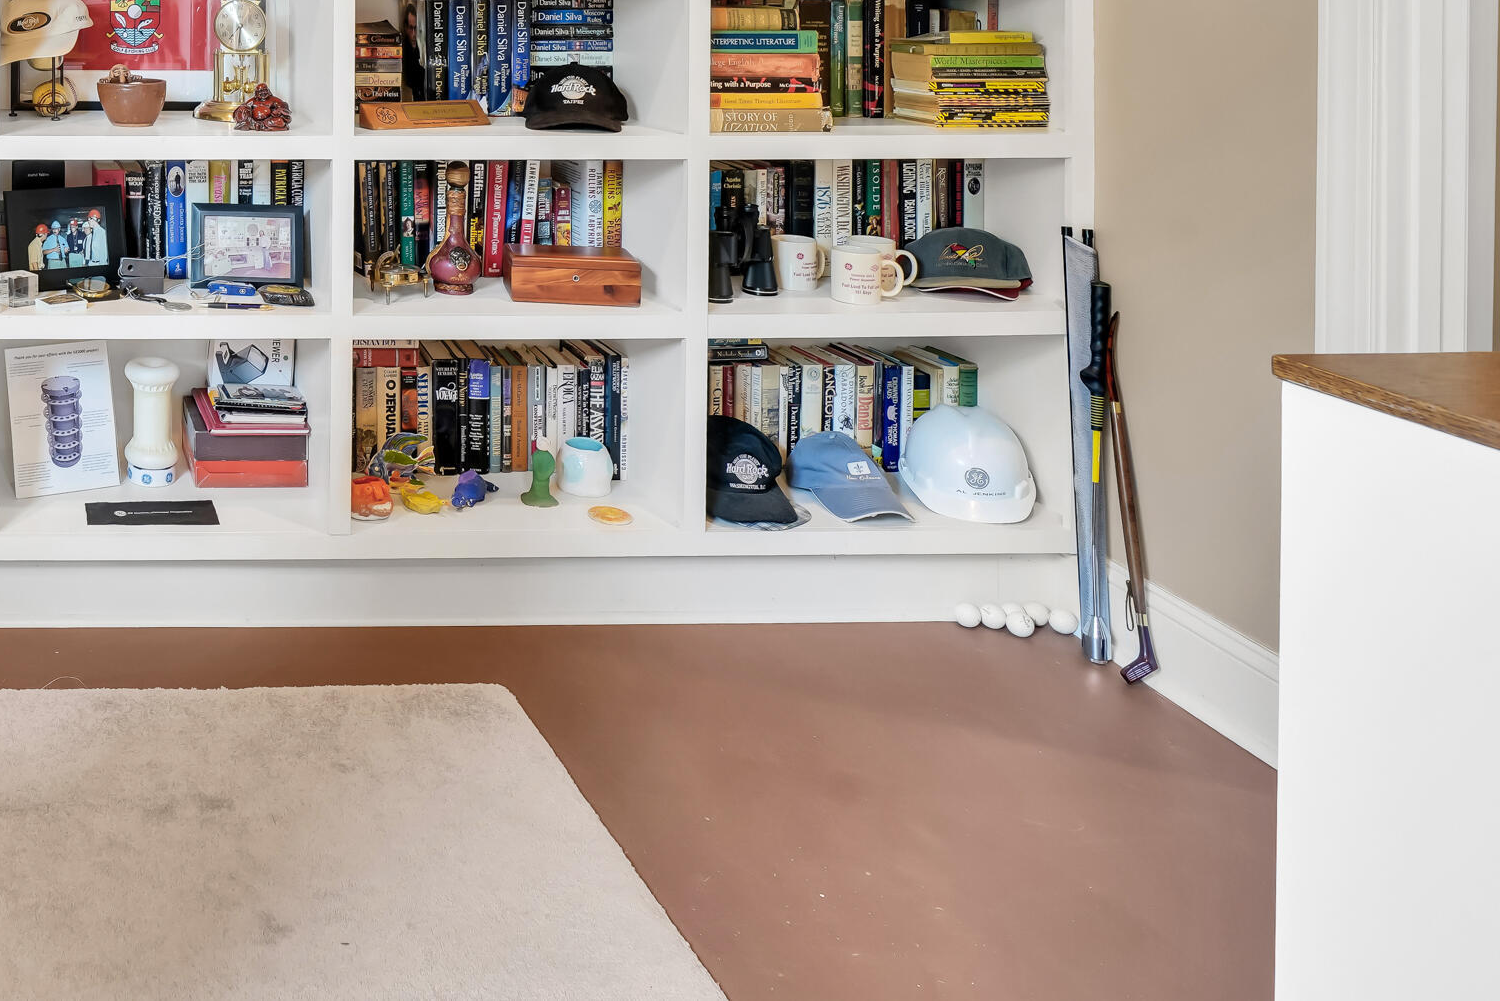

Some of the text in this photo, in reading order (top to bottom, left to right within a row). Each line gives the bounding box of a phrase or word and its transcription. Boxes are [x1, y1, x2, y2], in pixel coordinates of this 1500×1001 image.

[456, 5, 467, 62] Daniel Silva
[476, 3, 486, 56] Daniel Silva
[497, 4, 508, 61] Daniel Silva
[517, 1, 528, 53] Daniel Silva
[550, 83, 597, 97] Hard Rock
[725, 113, 778, 122] STORY OF
[274, 169, 288, 198] PATRICIA
[291, 161, 304, 189] PATRICIA
[474, 163, 486, 197] Griffin
[588, 168, 597, 199] ROLLINS
[607, 169, 615, 199] ROLLINS
[872, 162, 880, 210] ISOLDE
[816, 185, 832, 210] 1876
[271, 340, 281, 363] IEWER
[417, 372, 430, 420] SERPICO
[590, 386, 604, 407] THE
[840, 371, 848, 414] GABALDON
[726, 464, 769, 477] Hard Rock
